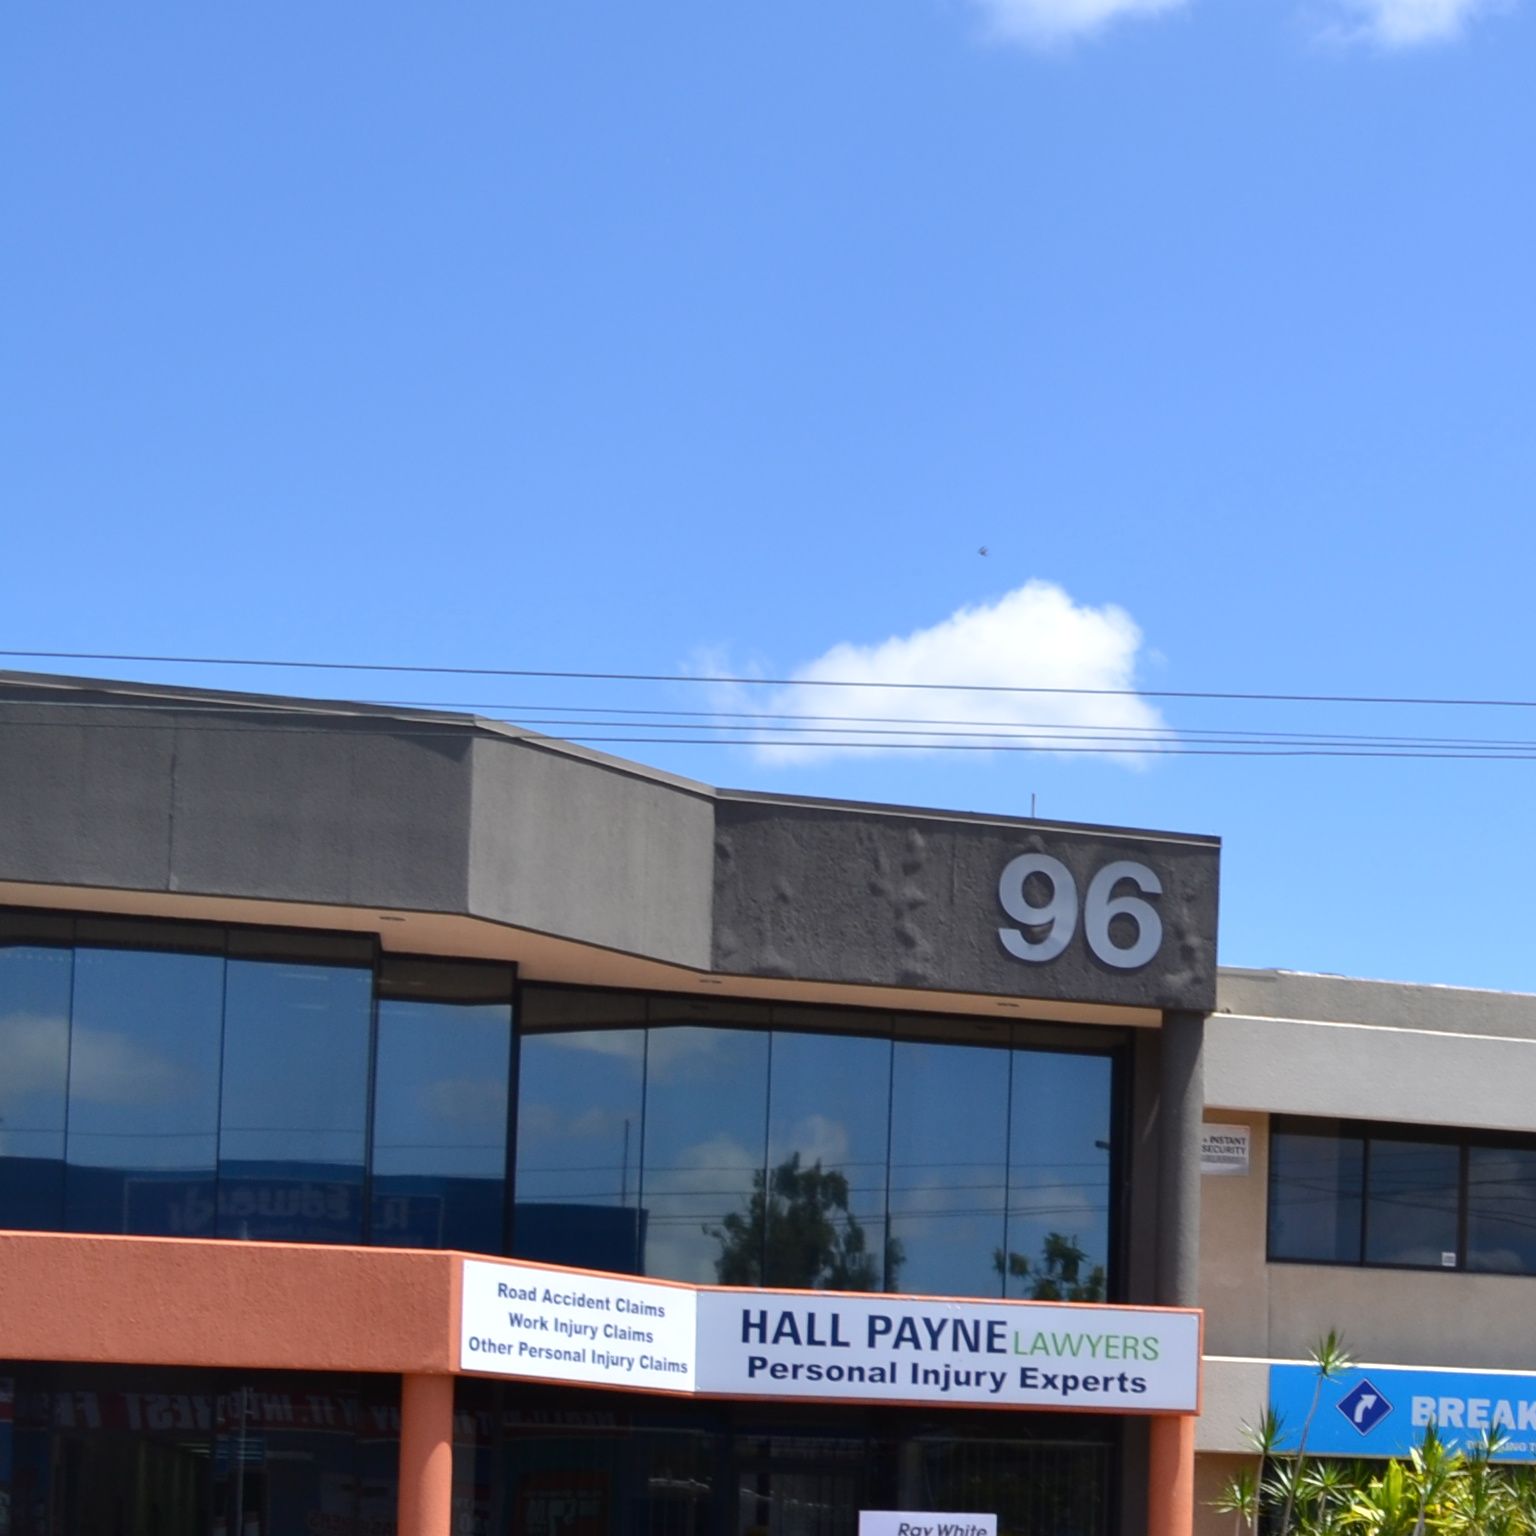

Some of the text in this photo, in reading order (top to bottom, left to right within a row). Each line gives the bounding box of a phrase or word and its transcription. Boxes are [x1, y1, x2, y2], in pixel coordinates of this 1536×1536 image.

[998, 853, 1163, 969] 96
[498, 1282, 665, 1318] Road Accident Claims
[508, 1312, 654, 1344] Work Injury Claims
[741, 1309, 1160, 1361] HALL PAYNE LAWYERS
[468, 1336, 688, 1374] Other Personal Injury Claims
[748, 1355, 1147, 1396] Personal Injury Experts
